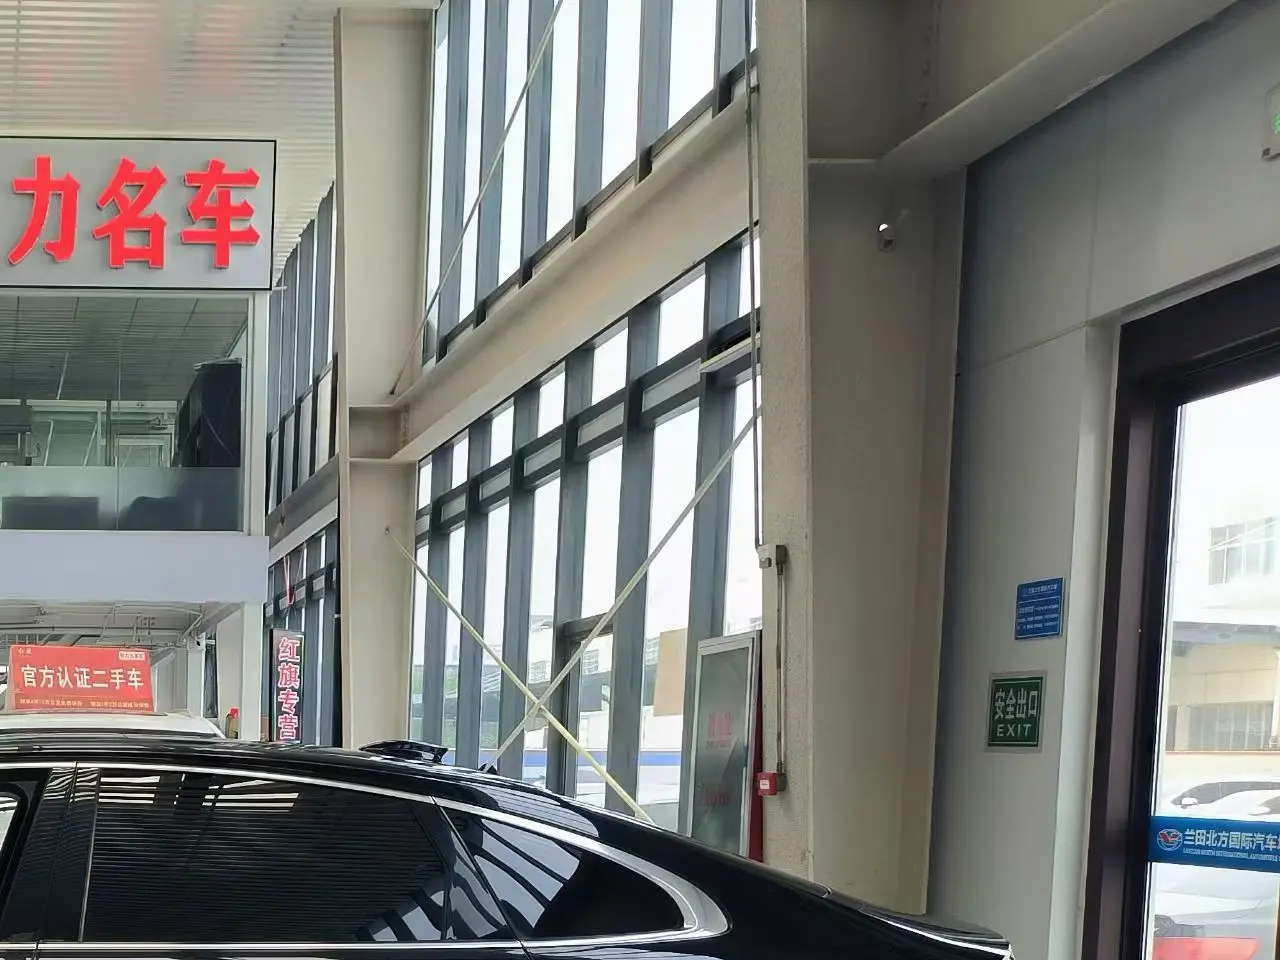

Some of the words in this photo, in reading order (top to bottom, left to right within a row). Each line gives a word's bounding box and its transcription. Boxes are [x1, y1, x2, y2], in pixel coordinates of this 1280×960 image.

[21, 664, 144, 691] 官方认证二手车
[277, 636, 301, 740] 红旗专营
[994, 687, 1038, 720] 安全出口
[996, 723, 1031, 737] EXIT
[1183, 828, 1280, 851] 兰田北方国际汽车
